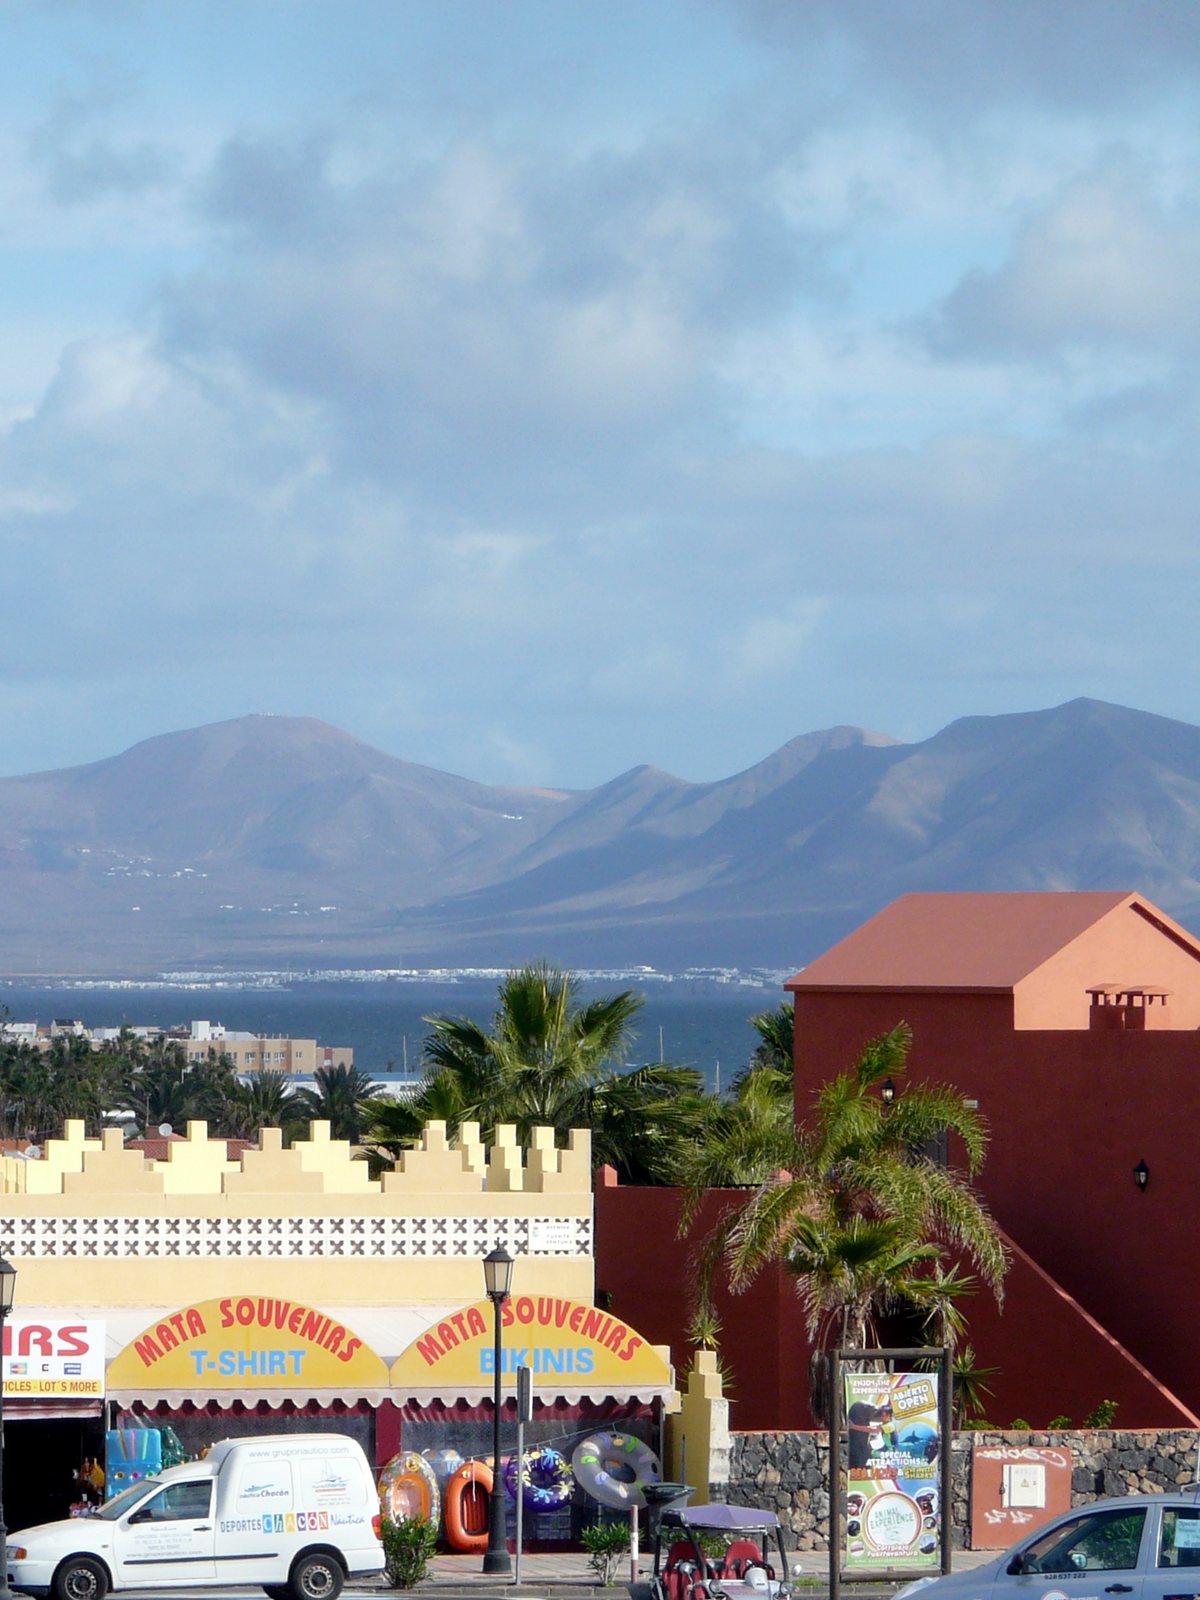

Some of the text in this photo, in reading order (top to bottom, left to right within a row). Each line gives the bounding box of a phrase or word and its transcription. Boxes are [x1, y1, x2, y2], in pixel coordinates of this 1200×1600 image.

[134, 1298, 362, 1368] MATA SOUVENIRS
[416, 1296, 644, 1366] MATA SOUVENIRS
[190, 1350, 306, 1376] T-SHIRT
[479, 1348, 594, 1374] BIKINIS
[70, 1381, 98, 1391] MORE
[893, 1384, 929, 1401] ABIERTO
[897, 1395, 929, 1410] OPEN
[880, 1451, 912, 1459] SPECIAL
[870, 1512, 914, 1529] EXPERIENCE
[874, 1507, 899, 1518] ANIMAL
[220, 1519, 262, 1533] DEPORTES
